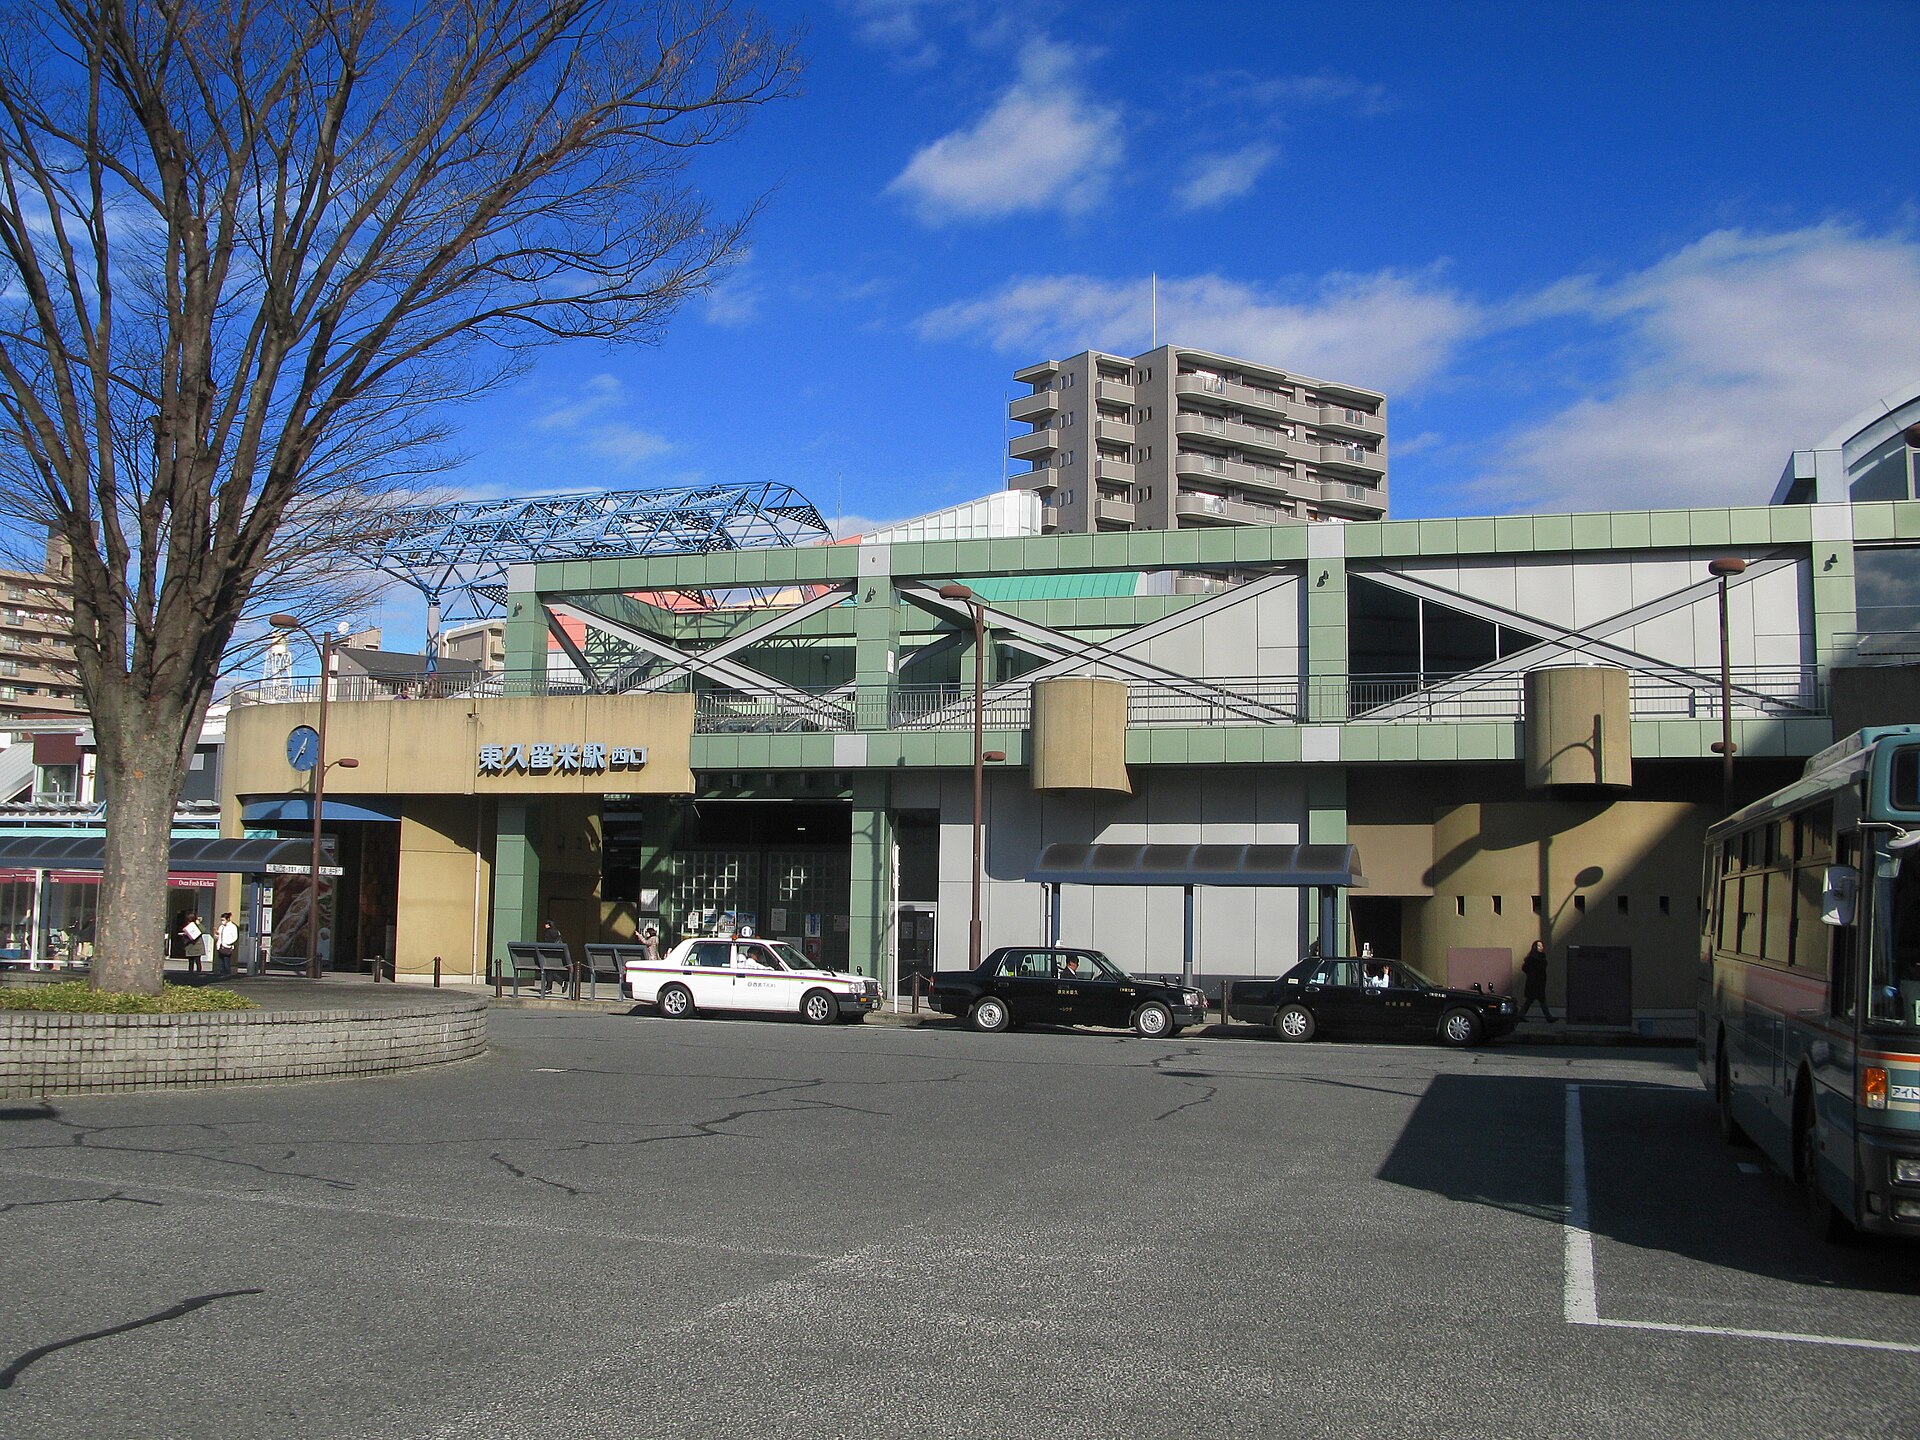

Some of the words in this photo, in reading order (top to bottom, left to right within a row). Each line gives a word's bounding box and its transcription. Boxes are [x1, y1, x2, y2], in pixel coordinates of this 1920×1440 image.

[479, 742, 606, 769] 東久留米駅
[611, 746, 647, 765] 西口
